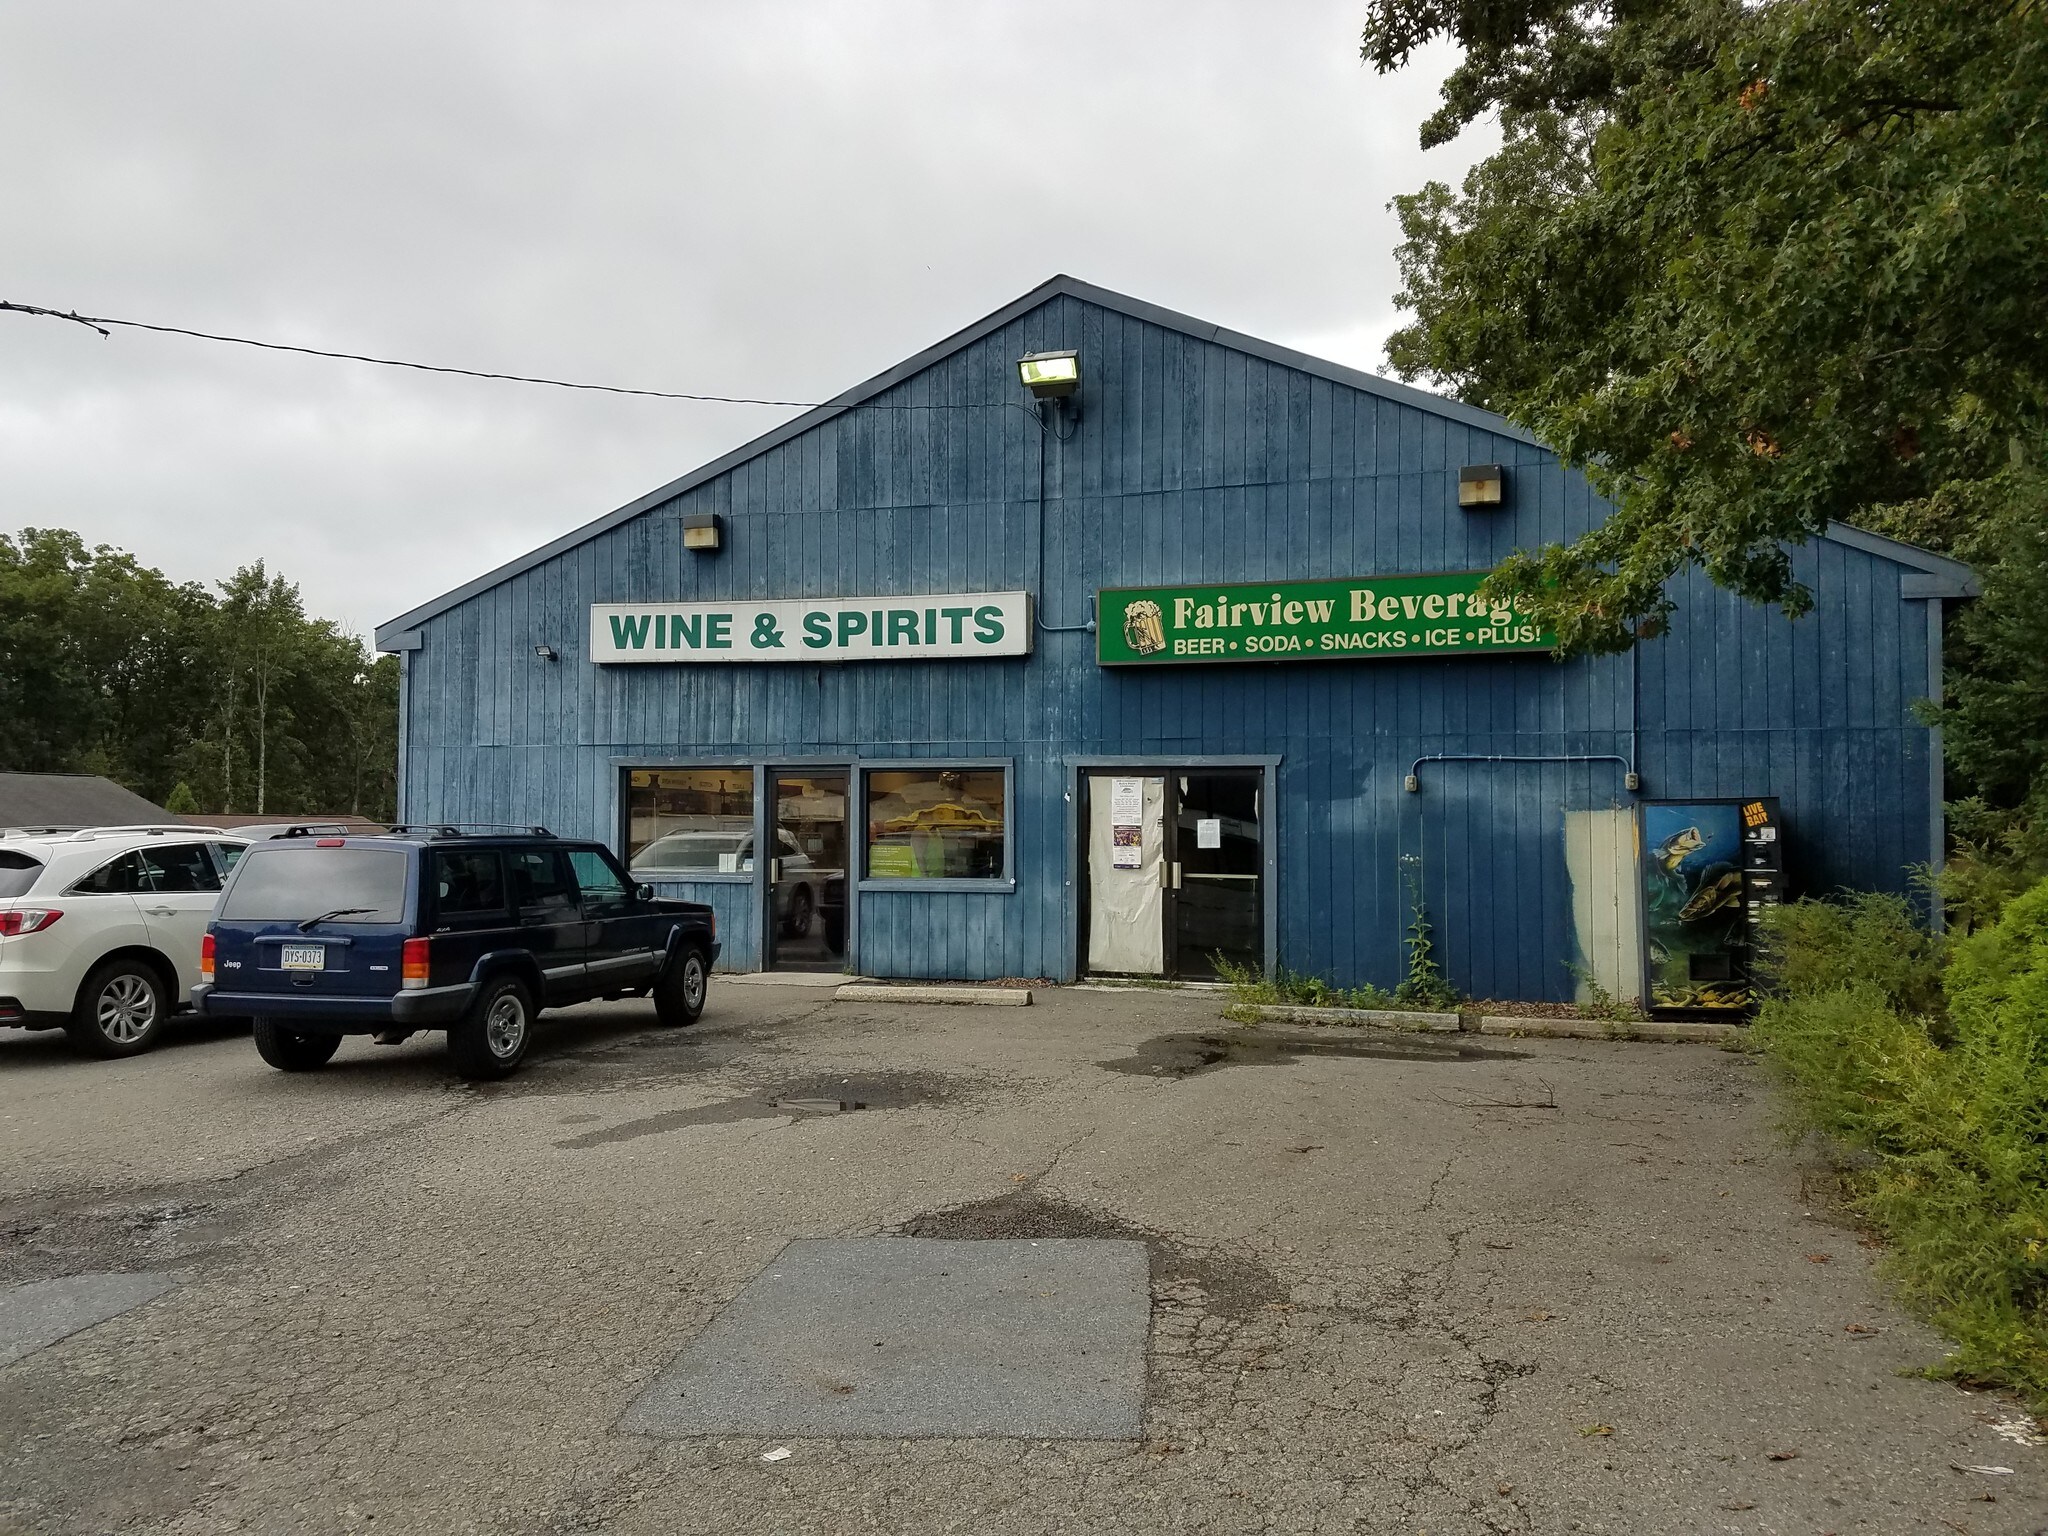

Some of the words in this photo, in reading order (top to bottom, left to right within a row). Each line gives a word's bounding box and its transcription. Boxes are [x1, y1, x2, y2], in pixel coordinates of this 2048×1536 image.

[1173, 593, 1335, 629] Fairview
[608, 613, 733, 650] WINE
[749, 612, 786, 649] &
[802, 605, 1006, 649] SPIRITS
[1173, 637, 1226, 656] BEER
[1244, 634, 1302, 653] SODA
[1320, 630, 1408, 650] SNACKS
[1425, 628, 1461, 647] ICE
[1743, 802, 1764, 817] LIVE
[1746, 812, 1768, 827] BAIT
[223, 959, 242, 970] Jeep
